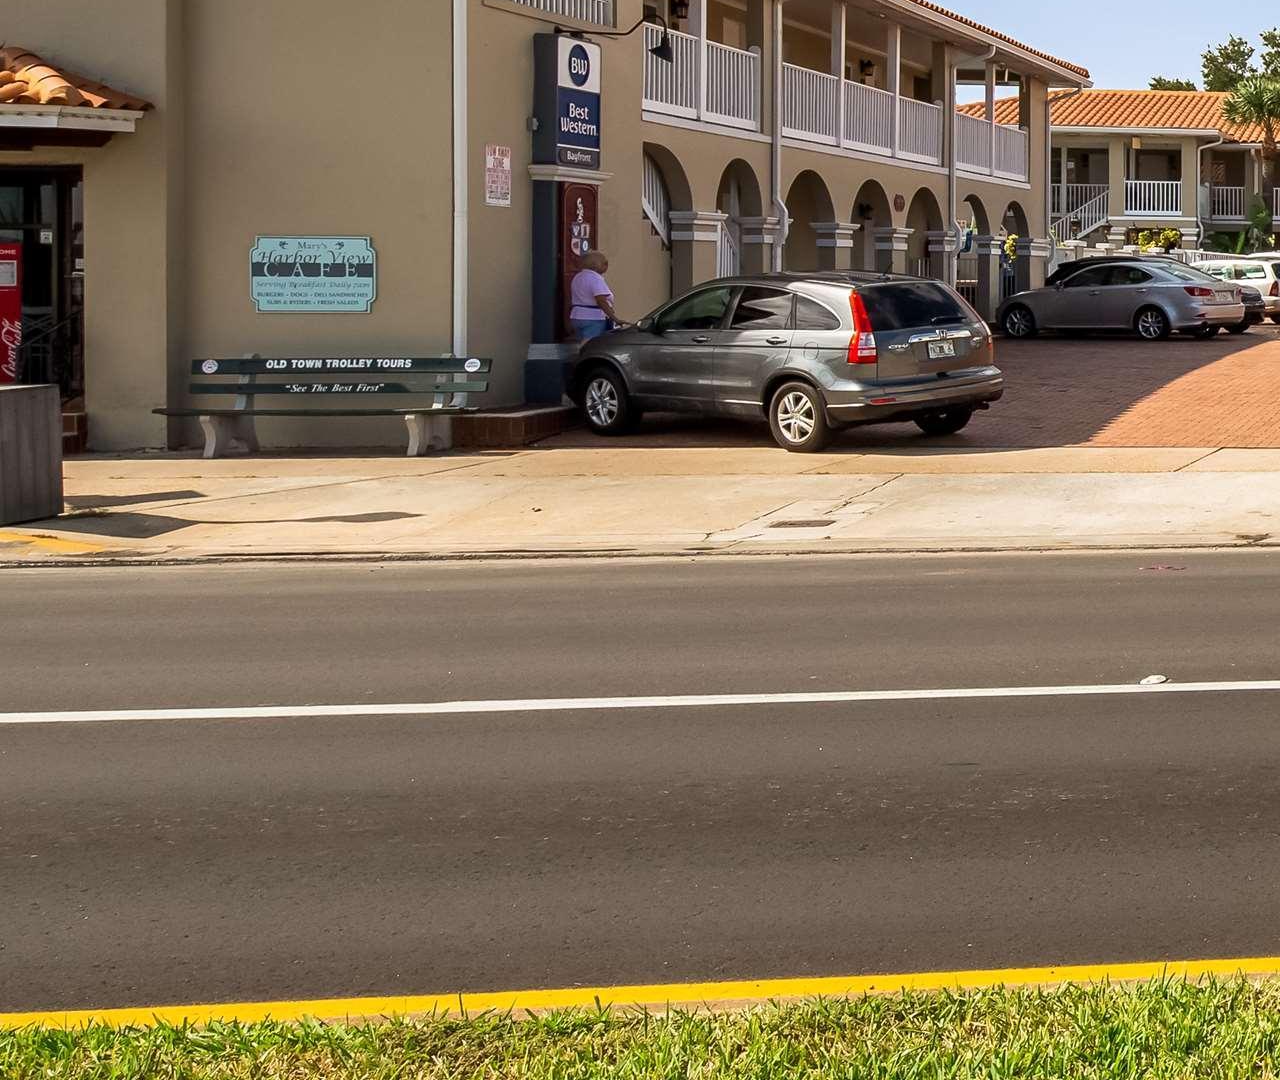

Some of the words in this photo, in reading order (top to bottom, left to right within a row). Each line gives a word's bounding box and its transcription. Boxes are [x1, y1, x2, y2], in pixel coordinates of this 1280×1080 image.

[571, 57, 588, 75] BW
[569, 103, 589, 120] Best
[567, 151, 591, 162] Bayfront
[298, 241, 327, 250] Mary's
[258, 250, 321, 263] Harbor
[328, 250, 370, 264] View
[289, 281, 328, 289] Breakfast
[265, 359, 287, 369] OLD
[291, 359, 323, 369] TOWN
[325, 359, 373, 369] TROLLEY
[376, 359, 412, 368] TOURS
[310, 384, 328, 393] The
[331, 384, 352, 393] Best
